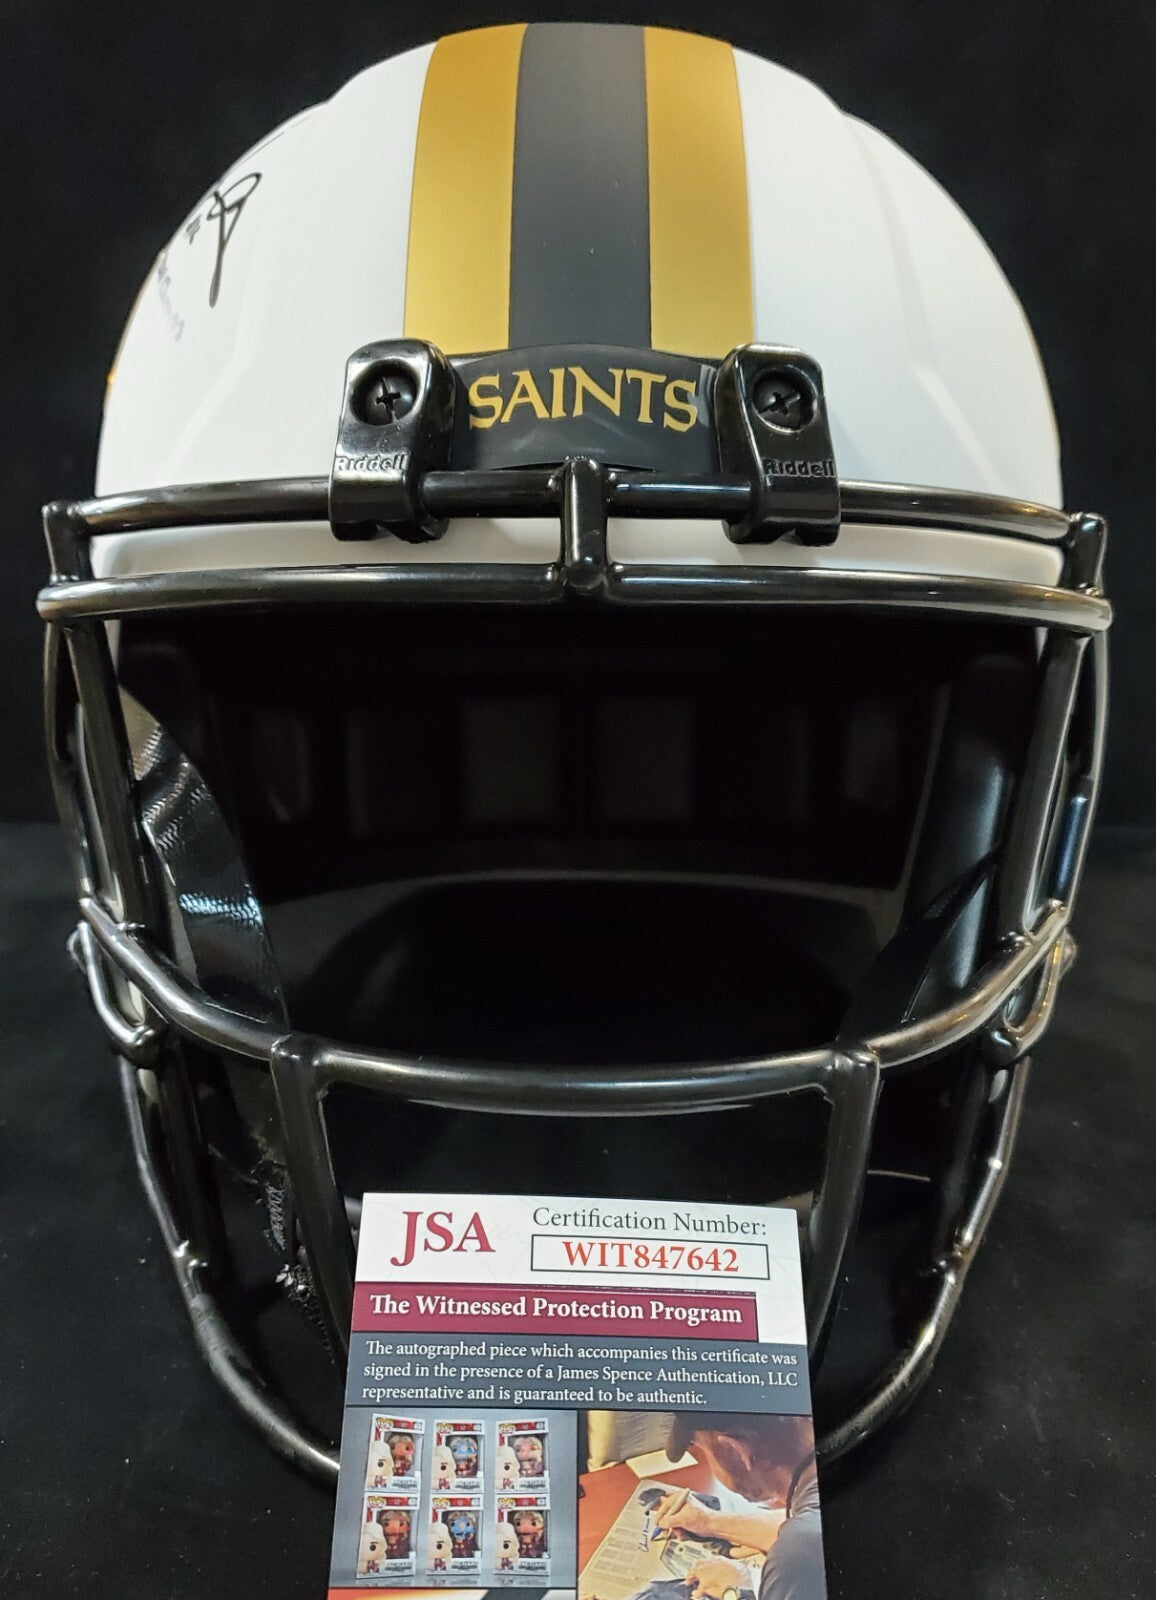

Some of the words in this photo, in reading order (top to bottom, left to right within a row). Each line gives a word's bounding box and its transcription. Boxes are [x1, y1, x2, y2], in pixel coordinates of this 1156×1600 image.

[468, 365, 697, 433] SAINTS
[334, 454, 409, 472] Riddell
[761, 458, 837, 478] Riddell
[533, 1207, 666, 1230] Certification
[673, 1212, 767, 1235] Number:
[390, 1211, 496, 1267] JSA
[563, 1241, 739, 1272] WIT847642
[370, 1294, 410, 1314] The
[416, 1295, 526, 1316] Witnessed
[532, 1297, 644, 1319] Protection
[649, 1301, 742, 1326] Program
[366, 1340, 392, 1355] The
[396, 1341, 486, 1359] autographed
[490, 1343, 527, 1360] piece
[530, 1343, 574, 1357] which
[578, 1347, 668, 1362] accompanies
[671, 1347, 698, 1361] this
[701, 1349, 768, 1363] certificate
[771, 1354, 798, 1365] was
[364, 1363, 411, 1380] signed
[415, 1364, 429, 1377] in
[434, 1363, 457, 1377] the
[460, 1367, 523, 1381] presence
[526, 1365, 544, 1378] of
[545, 1368, 553, 1378] a
[557, 1366, 599, 1381] James
[602, 1366, 653, 1384] Spence
[656, 1368, 764, 1387] Authentication,
[768, 1372, 798, 1386] LLC
[362, 1386, 464, 1402] representative
[467, 1386, 494, 1399] and
[499, 1387, 510, 1399] is
[514, 1387, 594, 1403] guaranteed
[598, 1390, 612, 1401] to
[616, 1389, 633, 1402] be
[637, 1390, 707, 1404] authentic.
